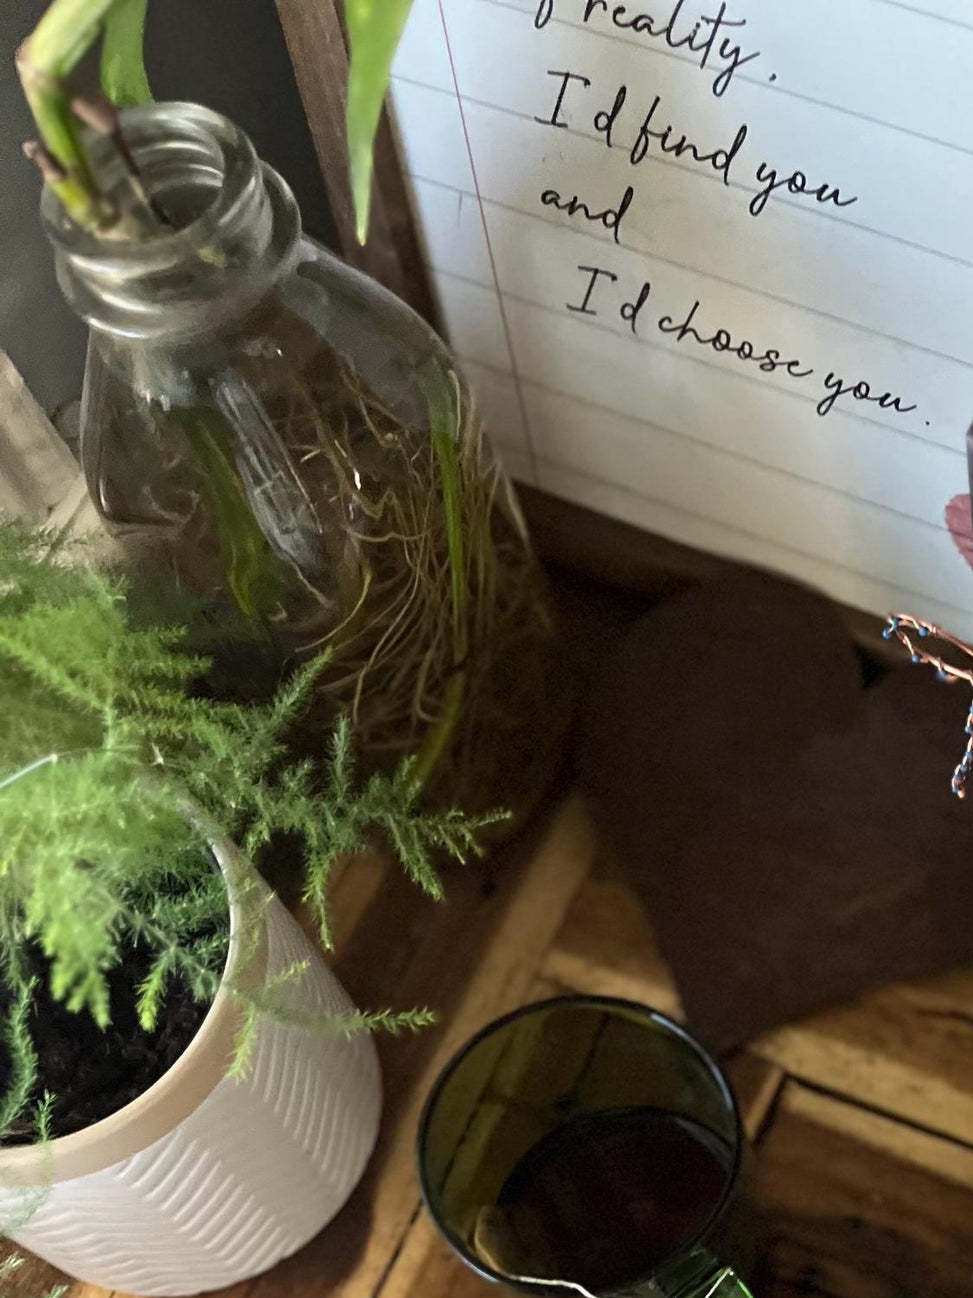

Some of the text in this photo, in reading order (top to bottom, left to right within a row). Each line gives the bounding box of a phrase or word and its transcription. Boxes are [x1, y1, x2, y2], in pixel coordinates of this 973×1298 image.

[583, 0, 778, 97] reality.
[630, 95, 747, 186] find
[748, 161, 858, 217] you
[540, 185, 634, 245] and
[657, 300, 814, 378] choose
[815, 371, 930, 427] you.
